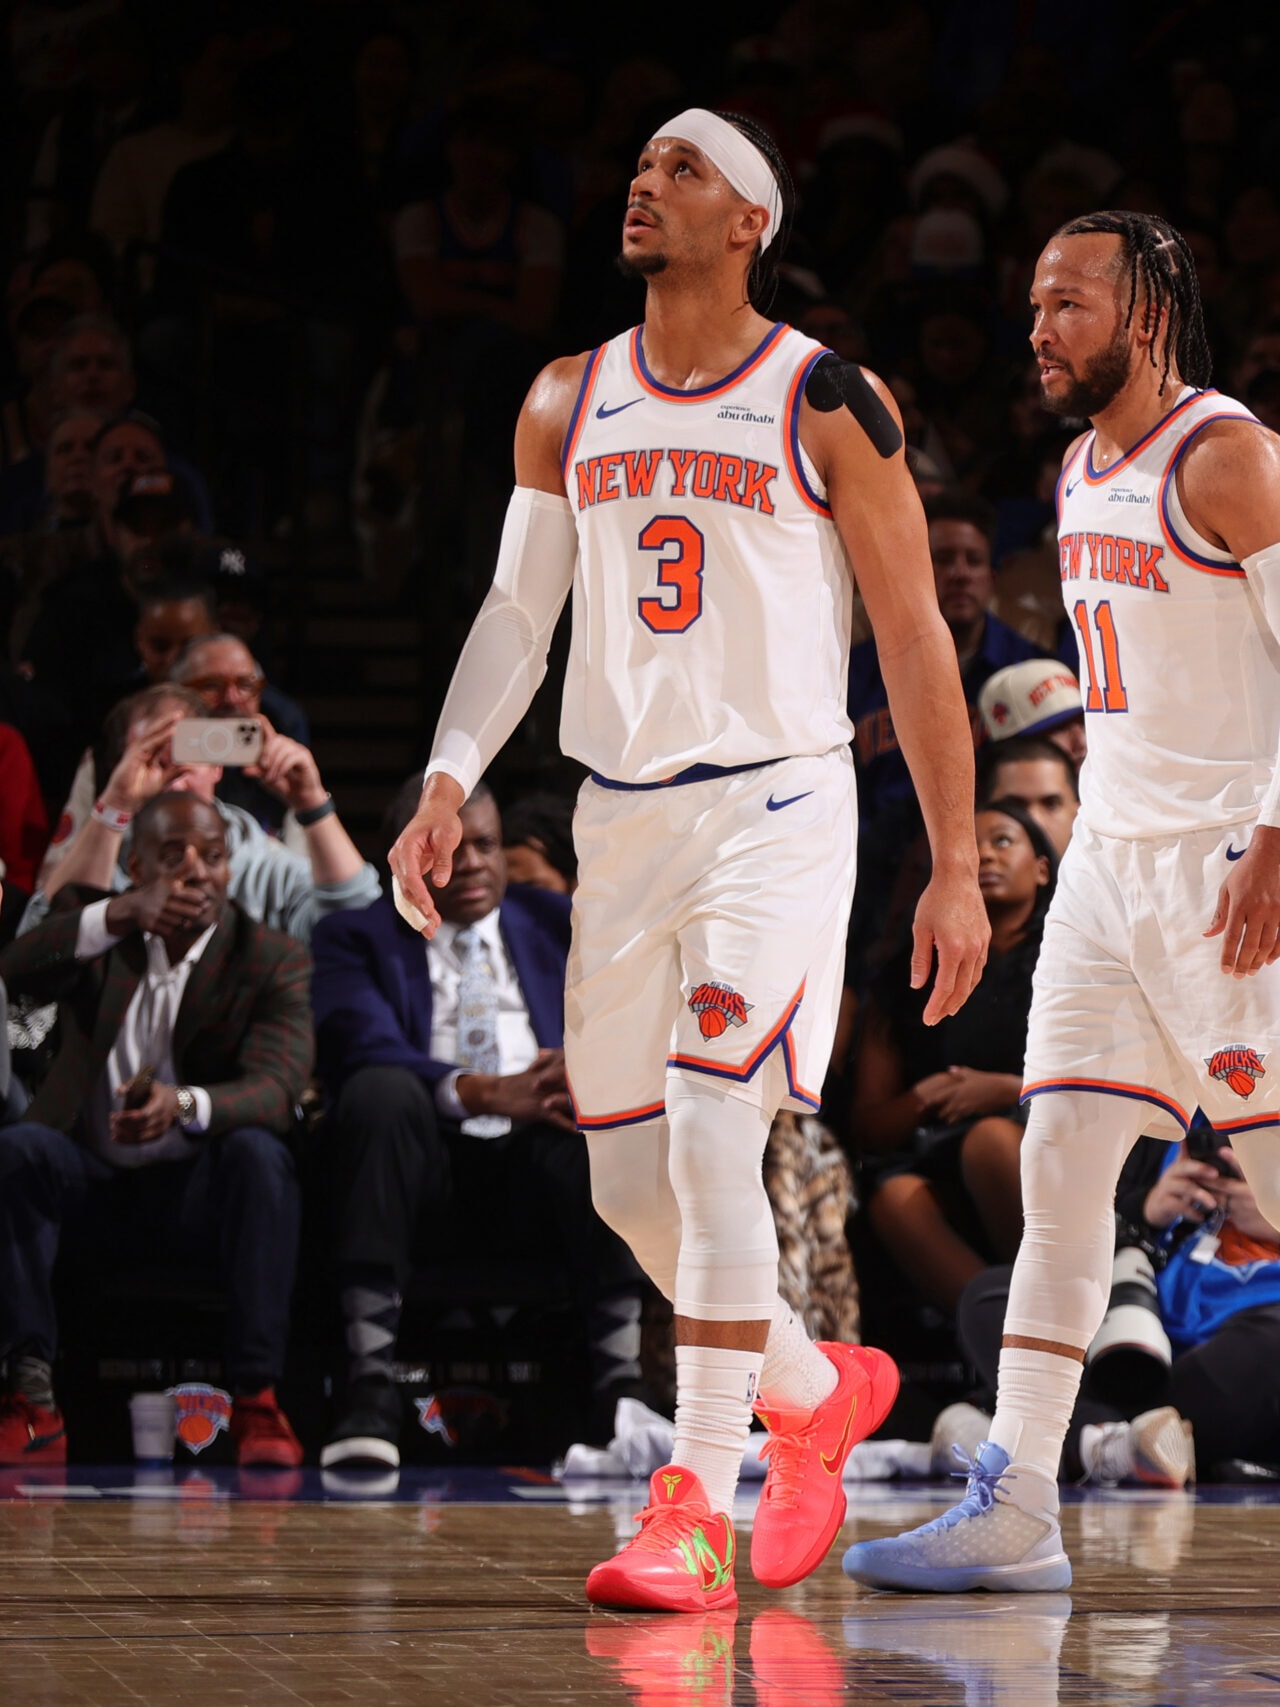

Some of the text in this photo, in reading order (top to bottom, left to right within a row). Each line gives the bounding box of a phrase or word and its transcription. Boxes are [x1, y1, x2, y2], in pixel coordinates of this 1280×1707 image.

[717, 411, 775, 424] abu dhabi
[575, 449, 778, 516] NEW YORK
[1108, 493, 1151, 504] abu dhabi
[638, 515, 705, 634] 3
[1059, 532, 1170, 594] EW YORK
[1073, 599, 1129, 713] 11
[688, 983, 748, 1024] KNICKS
[1209, 1048, 1266, 1077] KNICKS
